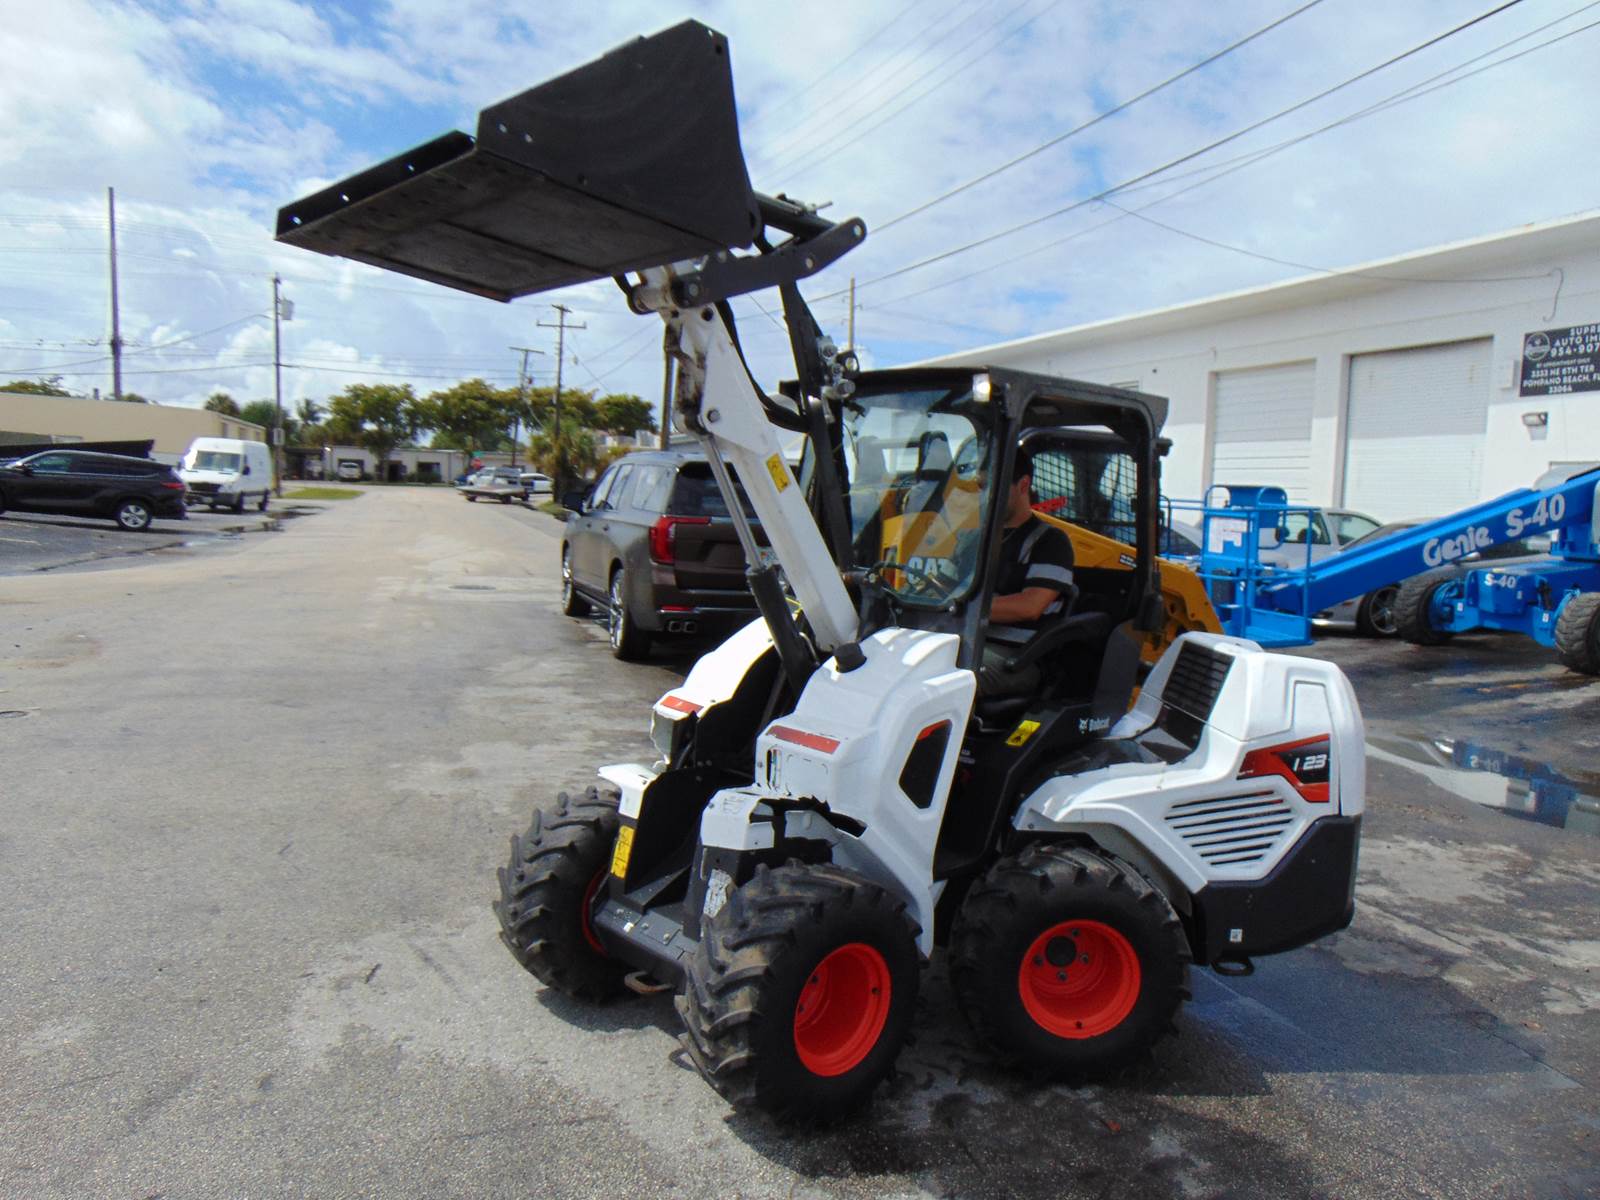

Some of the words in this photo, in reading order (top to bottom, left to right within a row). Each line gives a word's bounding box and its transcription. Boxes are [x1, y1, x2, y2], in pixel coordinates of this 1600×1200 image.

[1554, 336, 1583, 347] AUTO
[1585, 333, 1600, 344] IM
[1506, 493, 1566, 538] S-40
[1484, 573, 1516, 589] S-40
